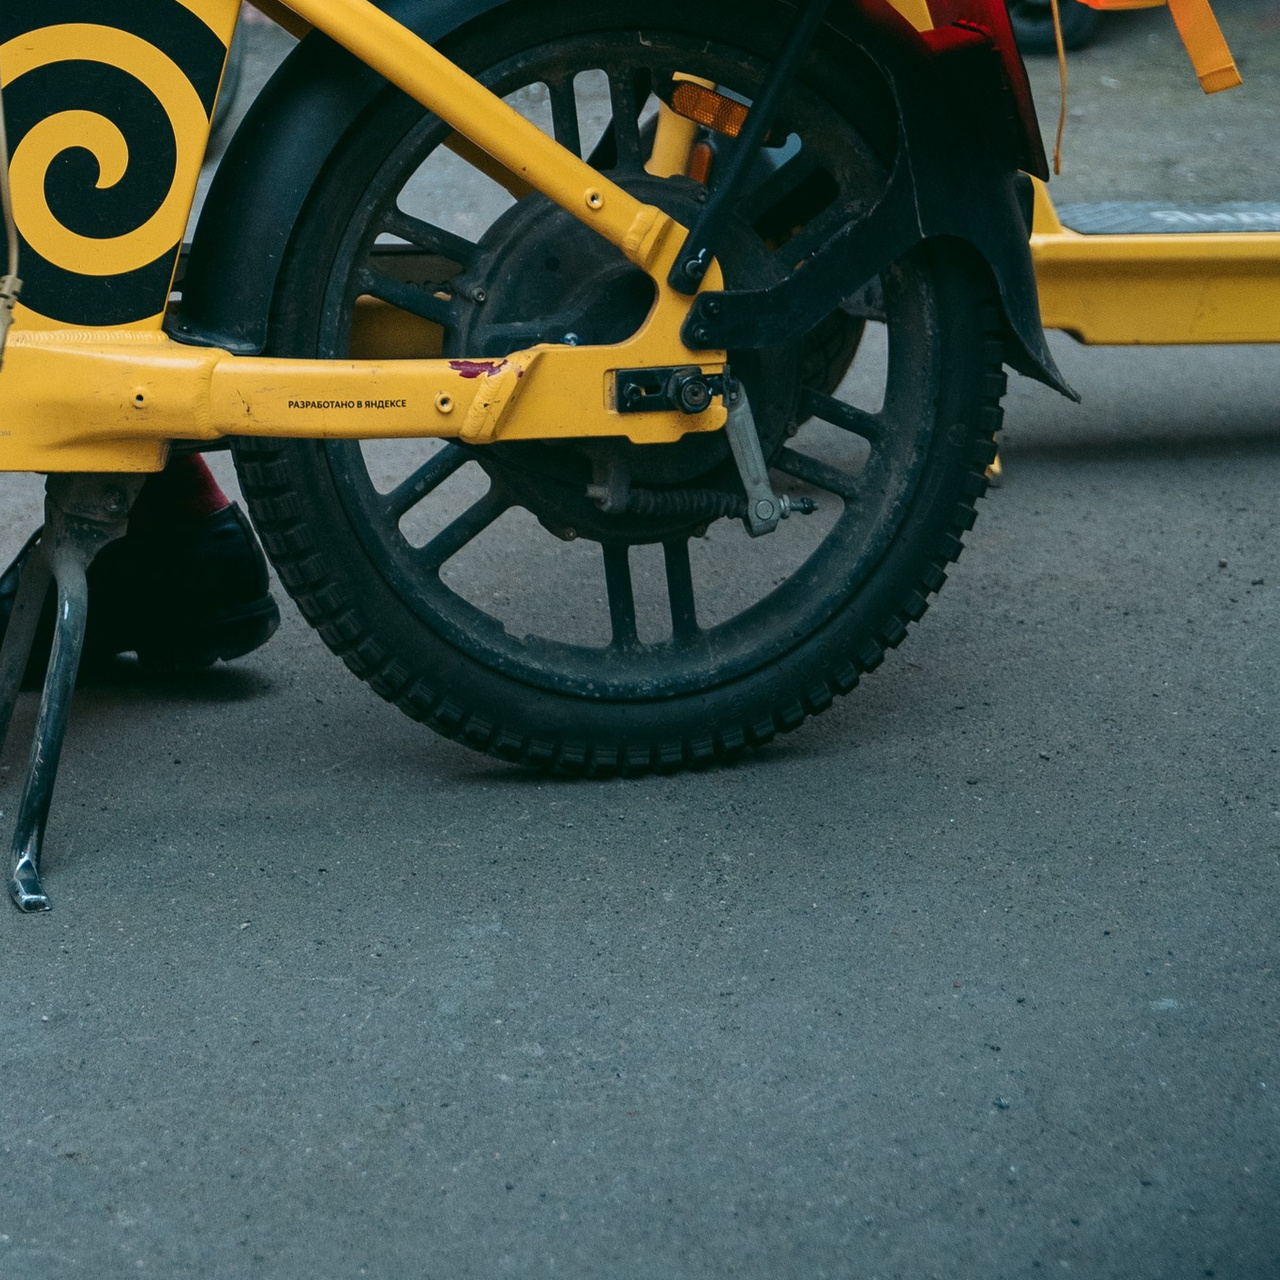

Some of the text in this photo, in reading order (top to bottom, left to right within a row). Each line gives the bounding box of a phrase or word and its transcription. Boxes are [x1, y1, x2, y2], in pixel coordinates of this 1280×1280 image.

[287, 399, 407, 410] РАЗРАБОТАНО В ЯНДЕКСЕ
